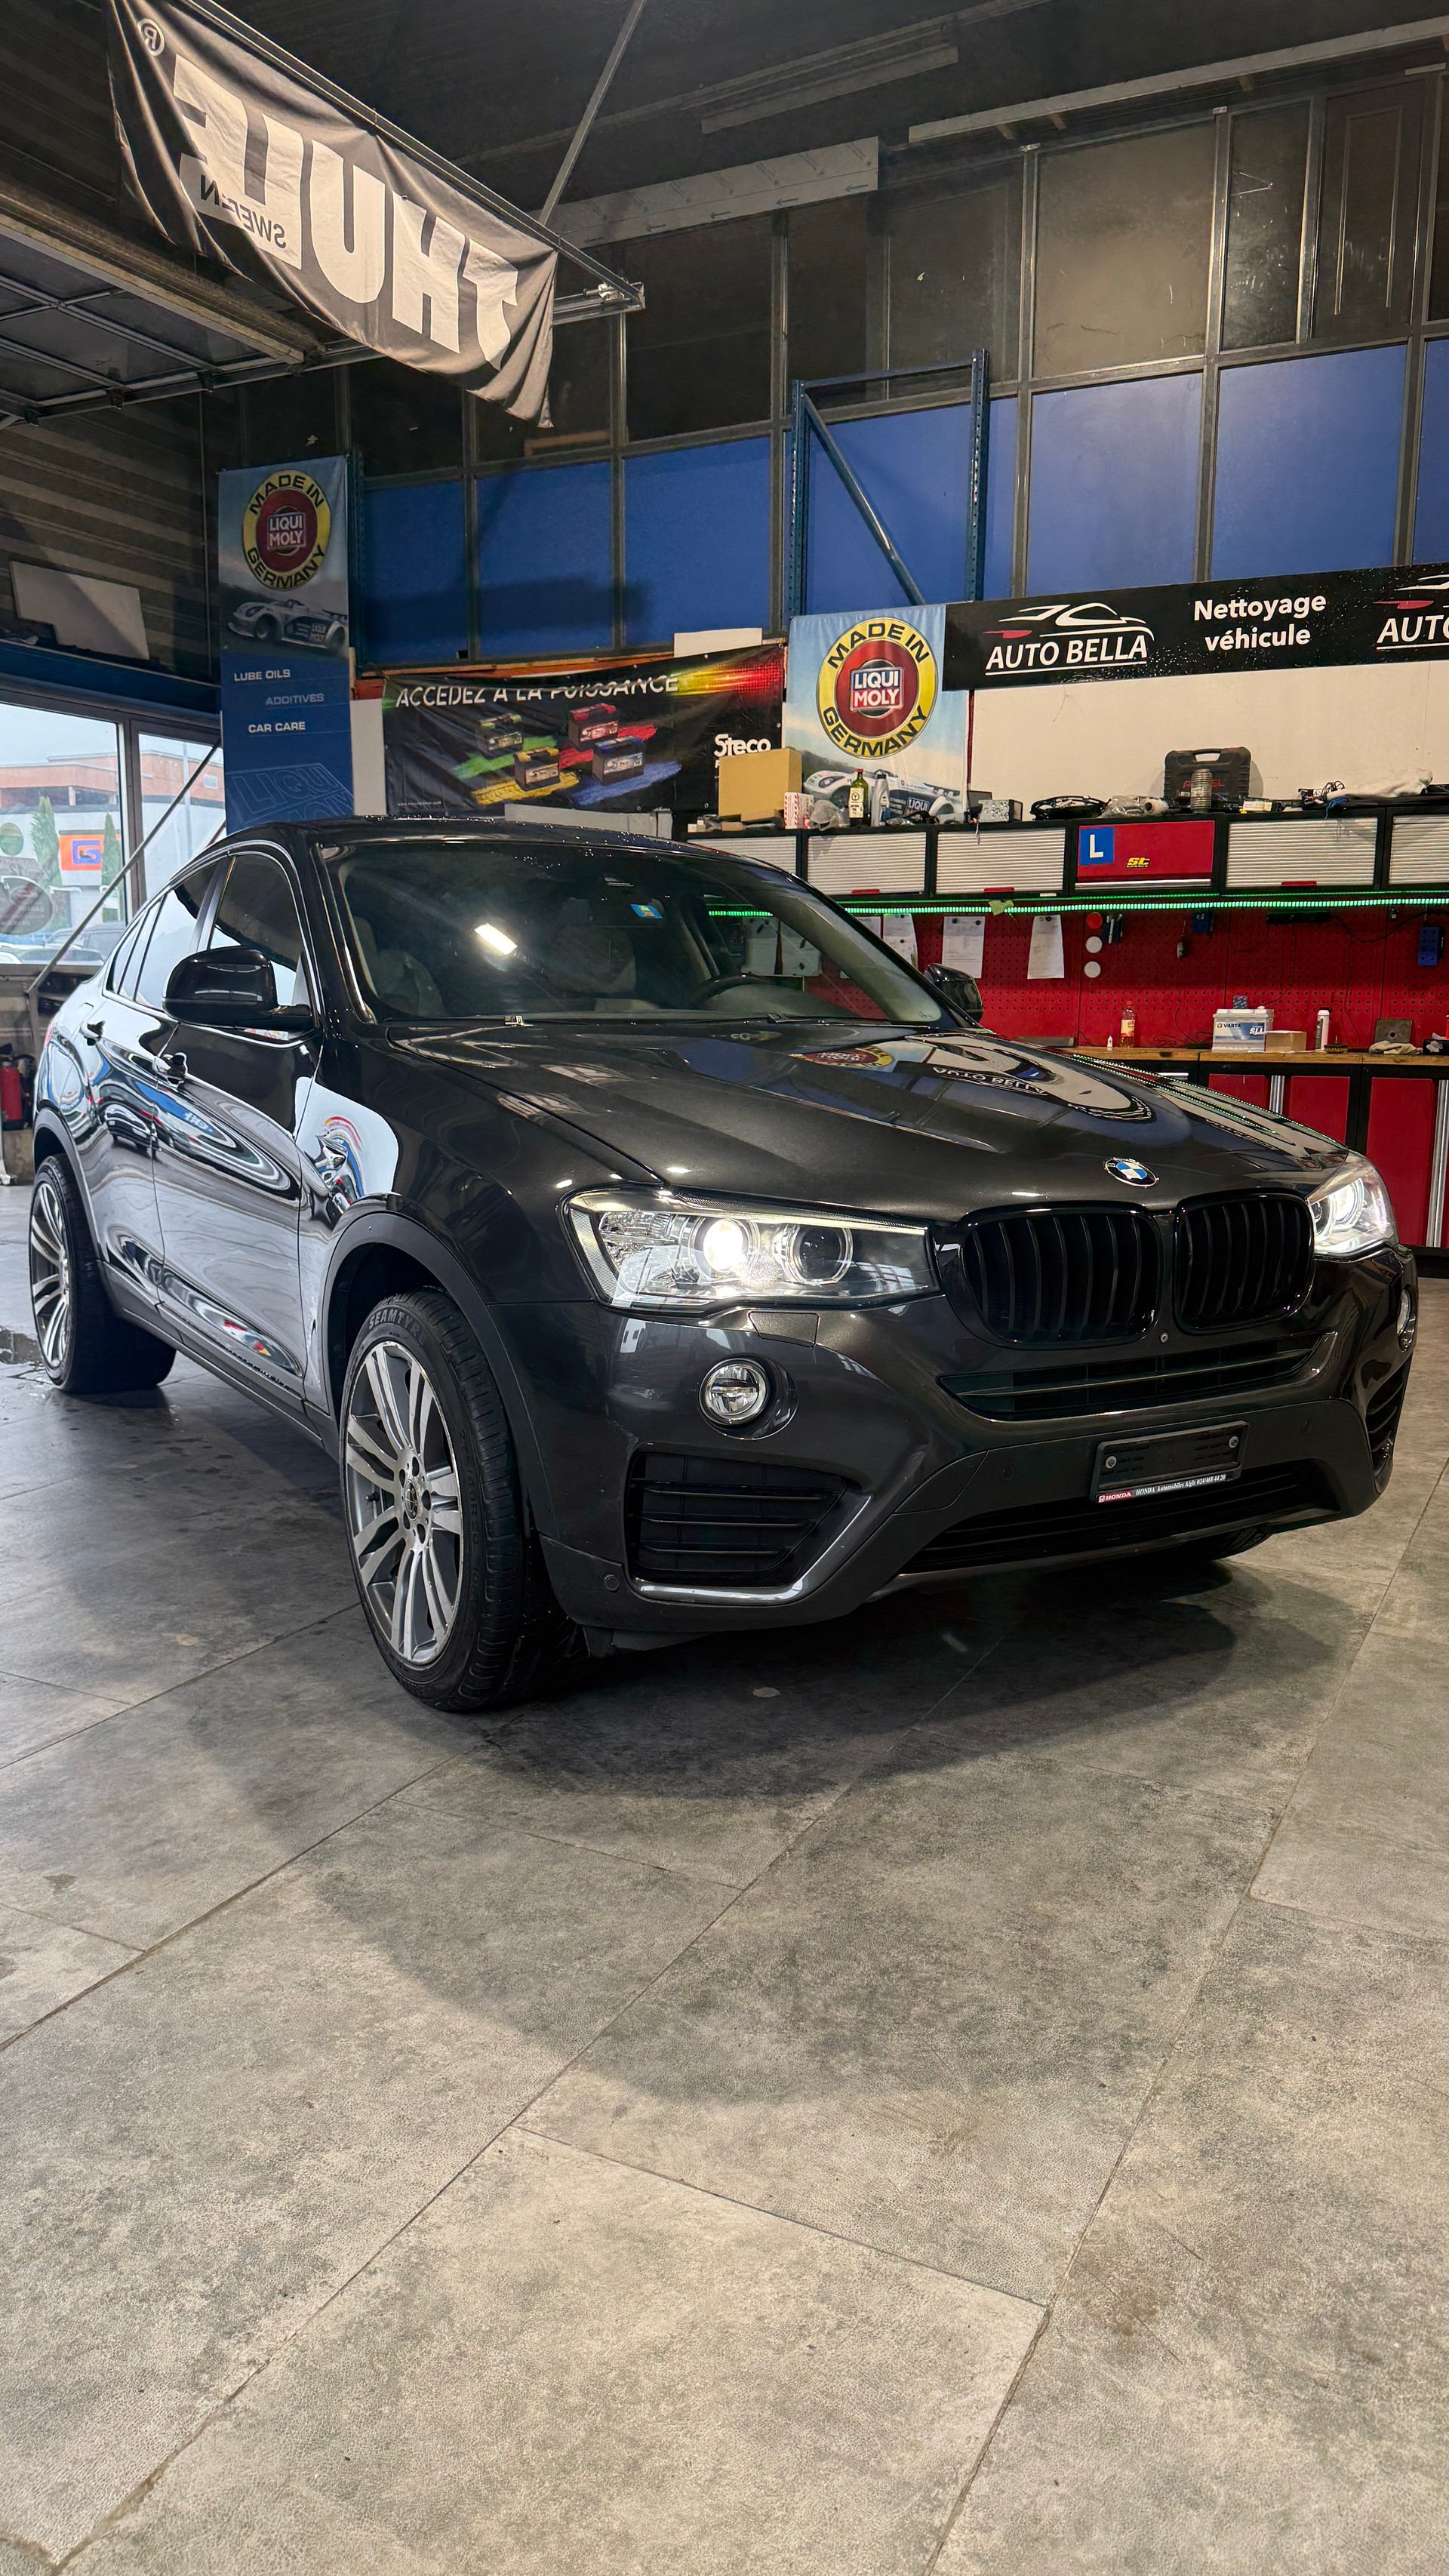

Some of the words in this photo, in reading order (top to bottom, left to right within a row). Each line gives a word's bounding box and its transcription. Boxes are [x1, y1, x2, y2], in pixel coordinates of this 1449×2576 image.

[249, 474, 306, 516] MADE
[306, 483, 325, 509] IN
[269, 515, 303, 531] LIQUI
[269, 530, 303, 546] MOLY
[247, 543, 325, 589] GERMANY
[1194, 595, 1327, 622] Nettoyage
[827, 622, 906, 669] MADE
[905, 632, 930, 663] IN
[1204, 623, 1311, 651] véhicule
[985, 641, 1060, 670] AUTO
[1066, 635, 1148, 664] BELLA
[234, 671, 263, 682] LUBE
[265, 669, 291, 679] OILS
[854, 670, 900, 689] LIQUI
[265, 693, 325, 706] ADDITIVES
[854, 688, 900, 707] MOLY
[248, 723, 272, 734] CAR
[275, 721, 306, 732] CARE
[823, 705, 928, 756] GERMANY
[713, 733, 771, 758] Steco
[232, 765, 340, 814] LIQUI
[1089, 834, 1104, 858] L
[1105, 1491, 1132, 1501] HONDA
[1135, 1488, 1155, 1496] HONDA
